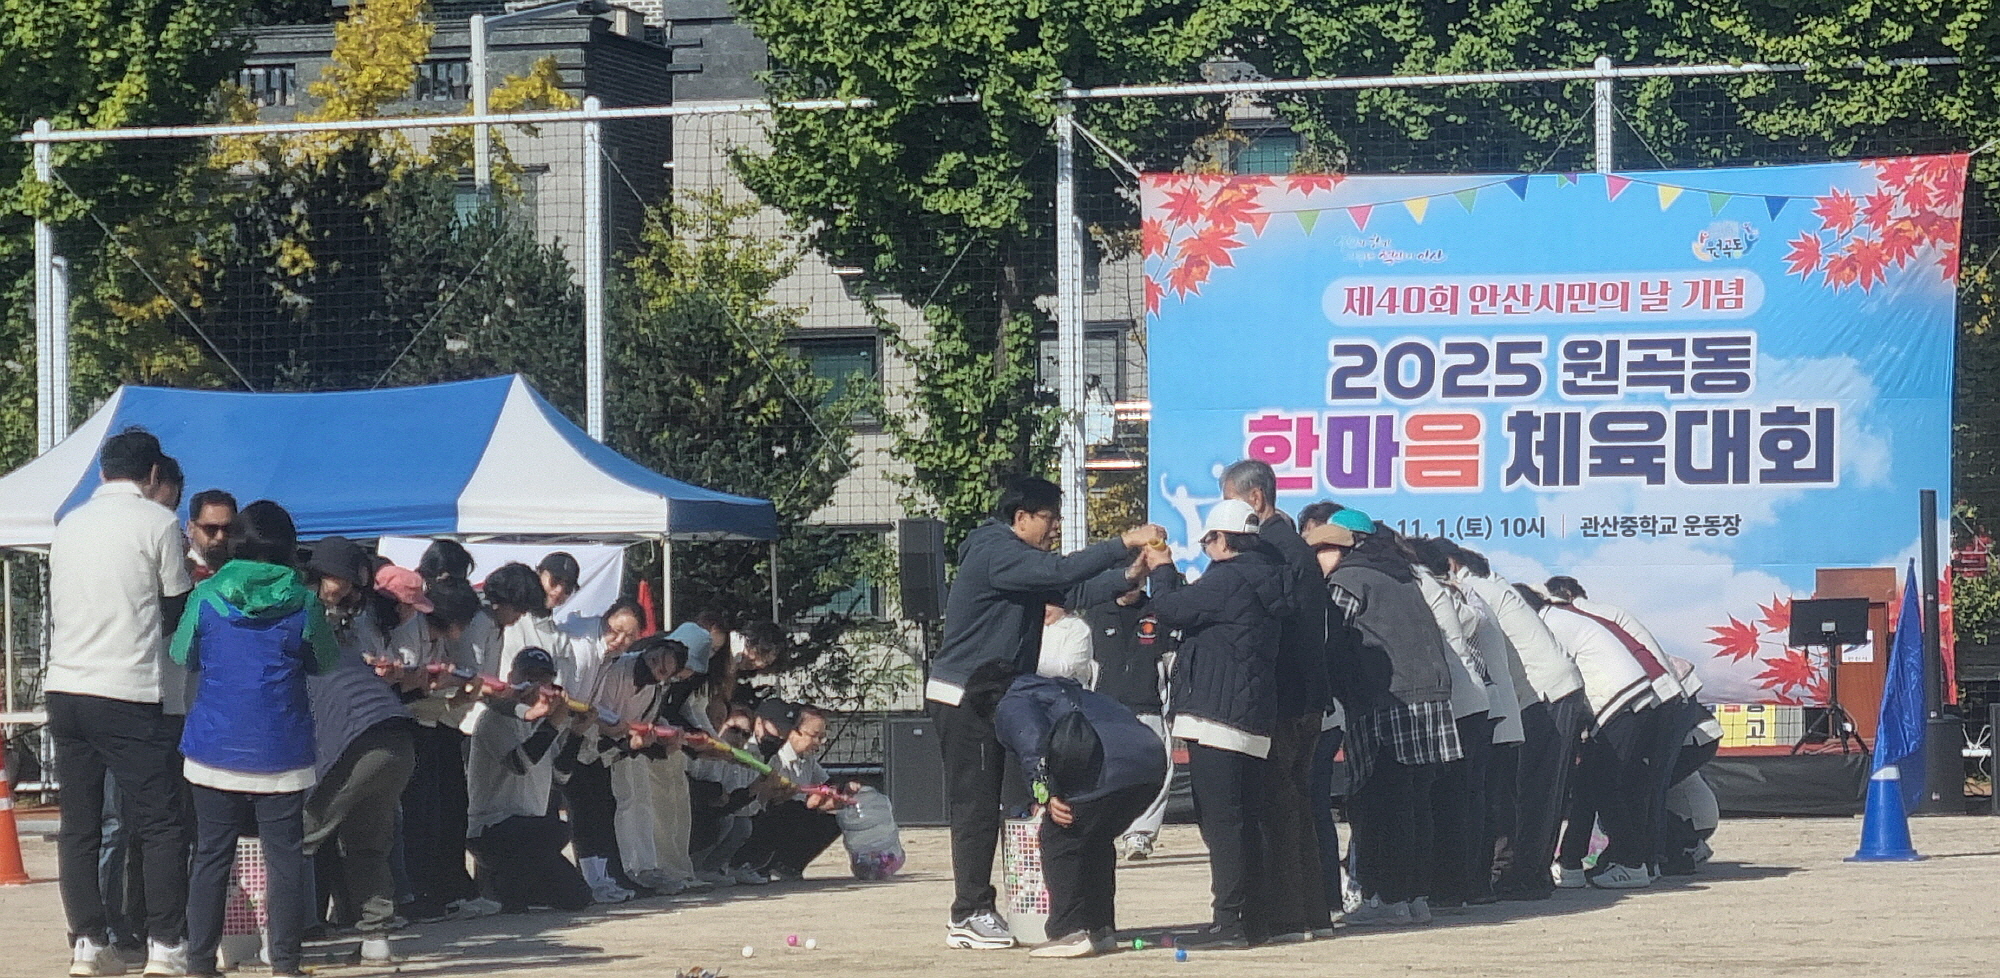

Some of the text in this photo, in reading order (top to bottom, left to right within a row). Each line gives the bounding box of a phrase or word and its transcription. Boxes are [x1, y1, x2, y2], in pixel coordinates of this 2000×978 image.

[1342, 278, 1745, 317] 제40회 안산시민의 날 기념
[1329, 336, 1752, 401] 2025 원곡동
[1245, 405, 1837, 490] 한마음 체육대회
[1436, 515, 1493, 541] 1.(토)
[1500, 516, 1546, 539] 10시
[1580, 514, 1678, 540] 관산중학교
[1682, 512, 1742, 539] 운동장
